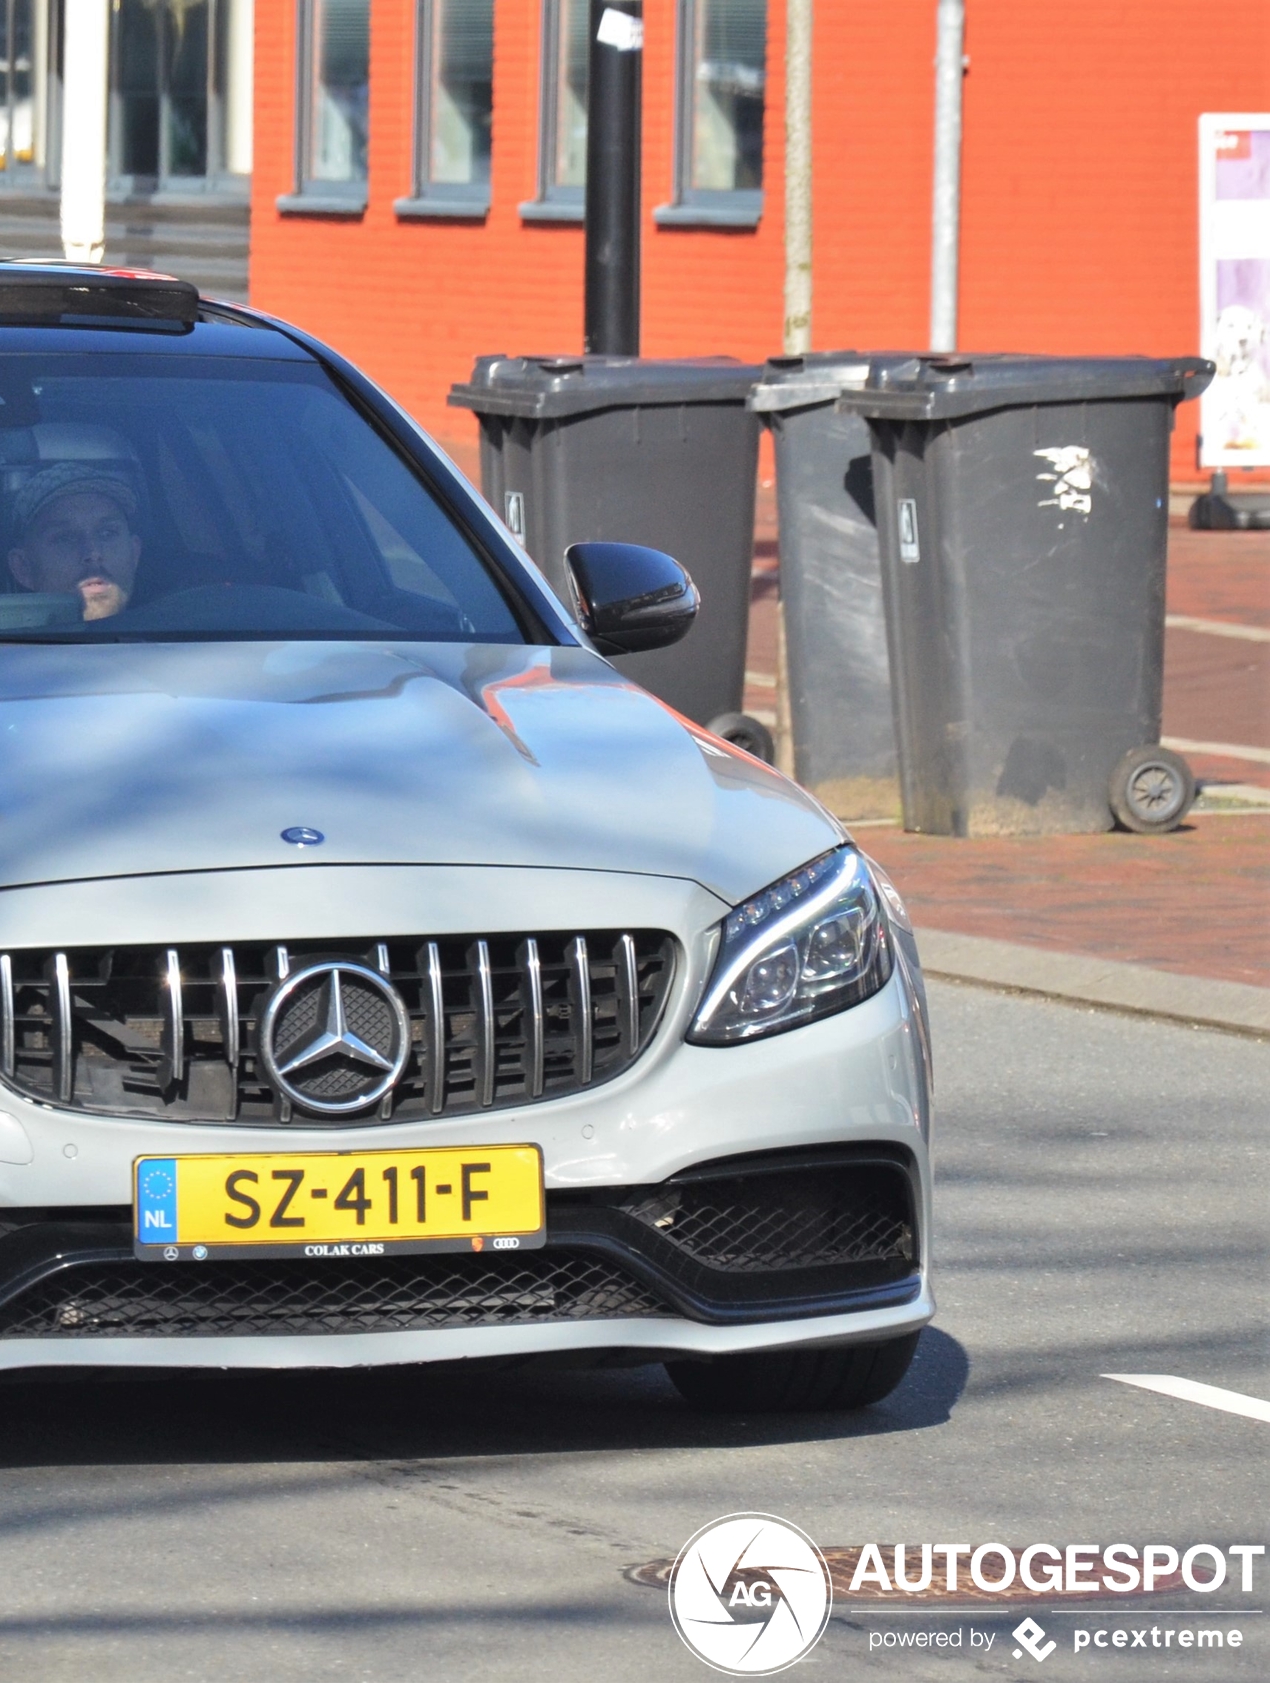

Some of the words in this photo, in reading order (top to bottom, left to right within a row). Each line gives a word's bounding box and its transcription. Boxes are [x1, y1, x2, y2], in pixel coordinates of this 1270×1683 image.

[224, 1162, 492, 1229] SZ-411-F
[144, 1210, 172, 1229] NL
[304, 1244, 350, 1256] COLAK
[351, 1243, 385, 1255] CARS
